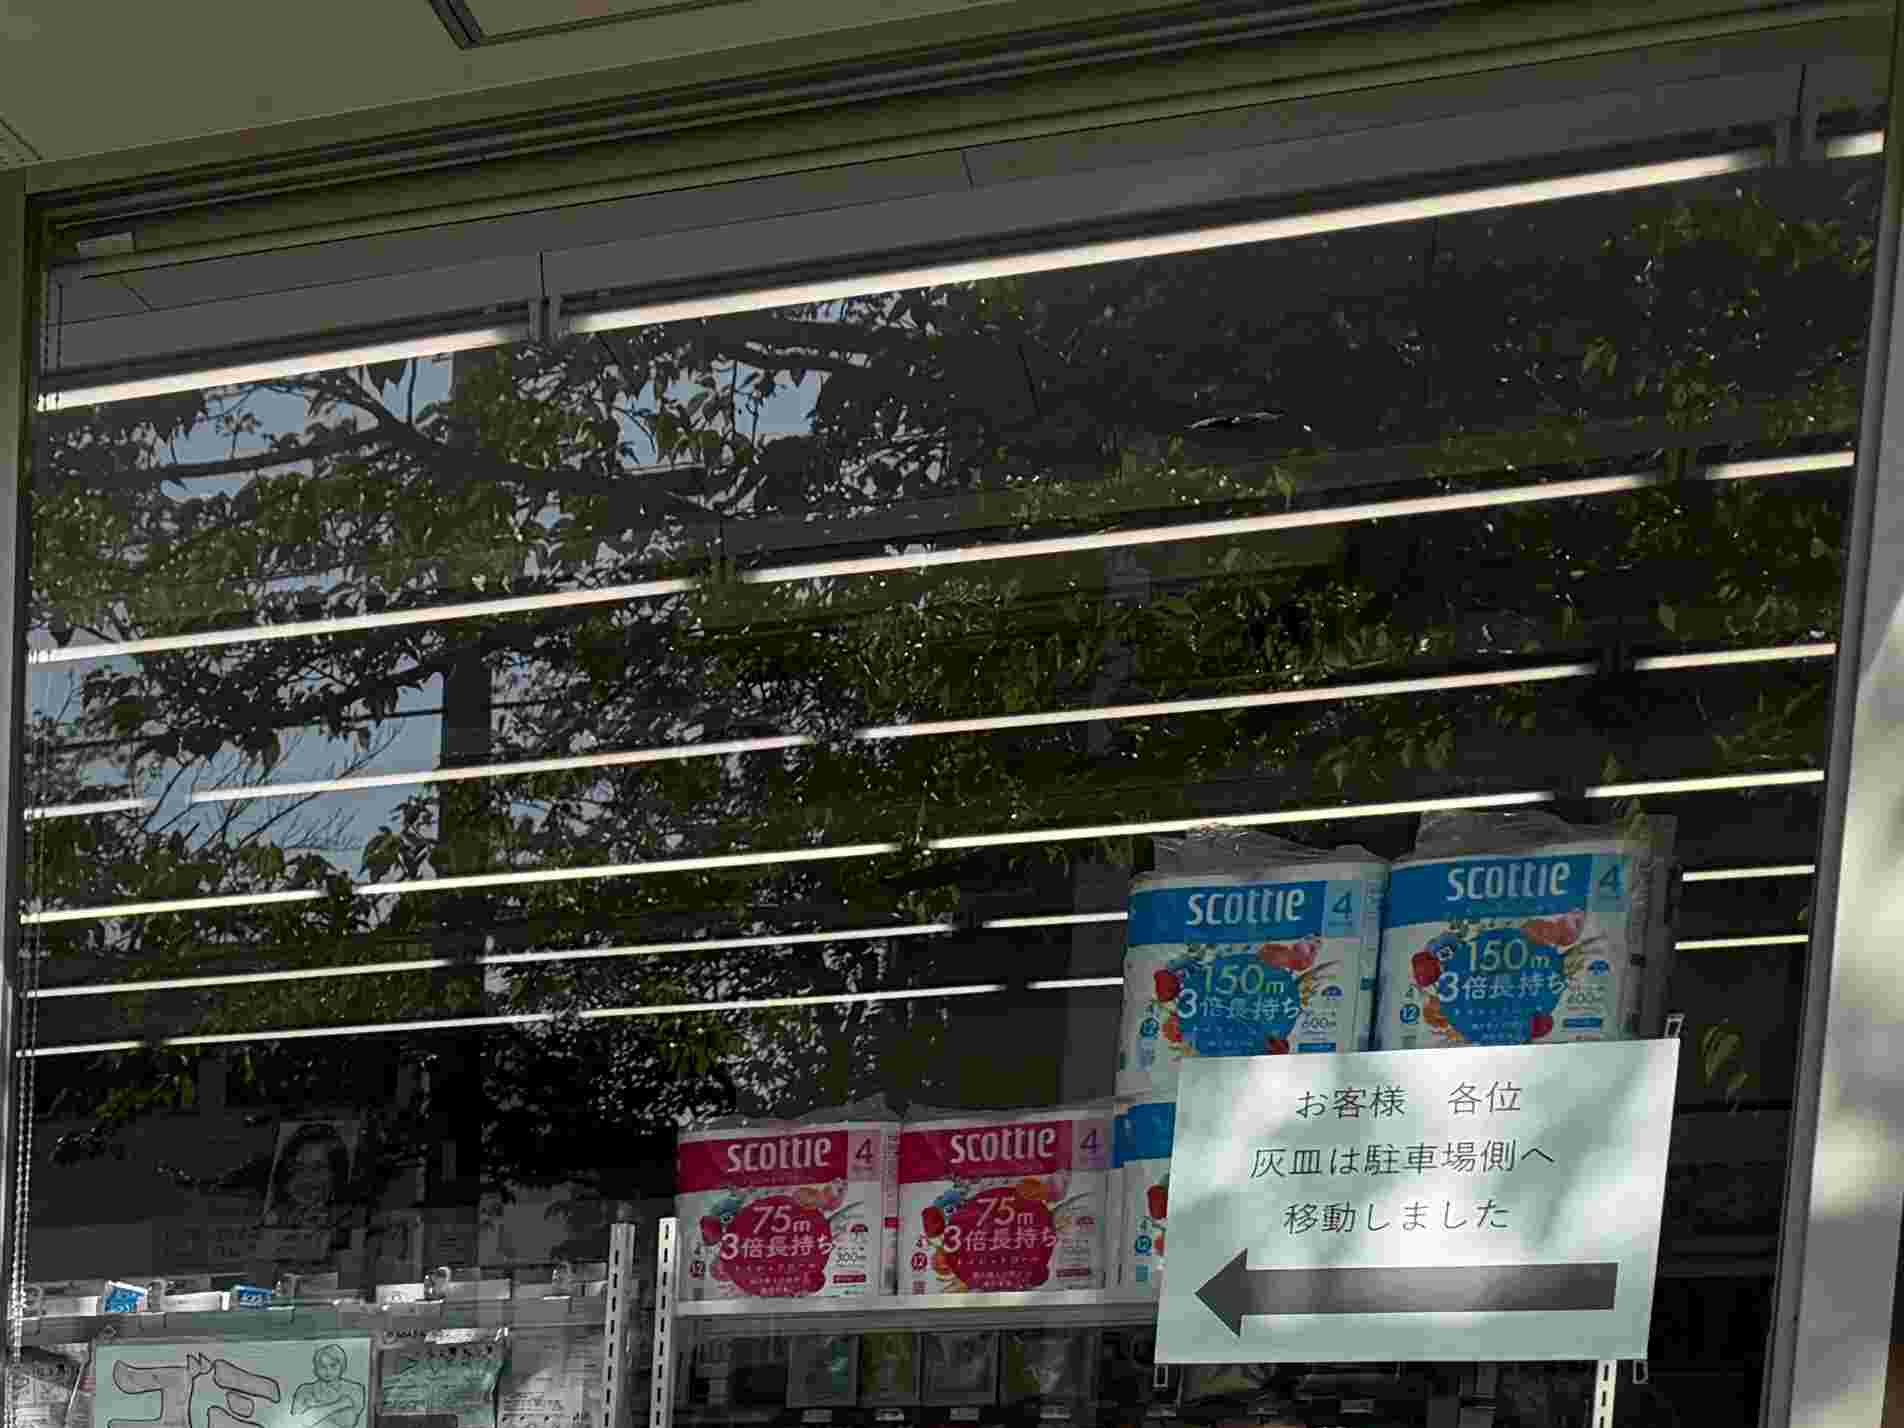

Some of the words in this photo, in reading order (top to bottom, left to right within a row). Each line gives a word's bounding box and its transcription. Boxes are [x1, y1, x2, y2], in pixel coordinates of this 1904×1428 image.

[1296, 1085, 1406, 1119] お客様
[1448, 1081, 1522, 1115] 各位
[1250, 1138, 1556, 1179] 灰皿は駐車場側へ
[1283, 1199, 1511, 1235] 移動しました
